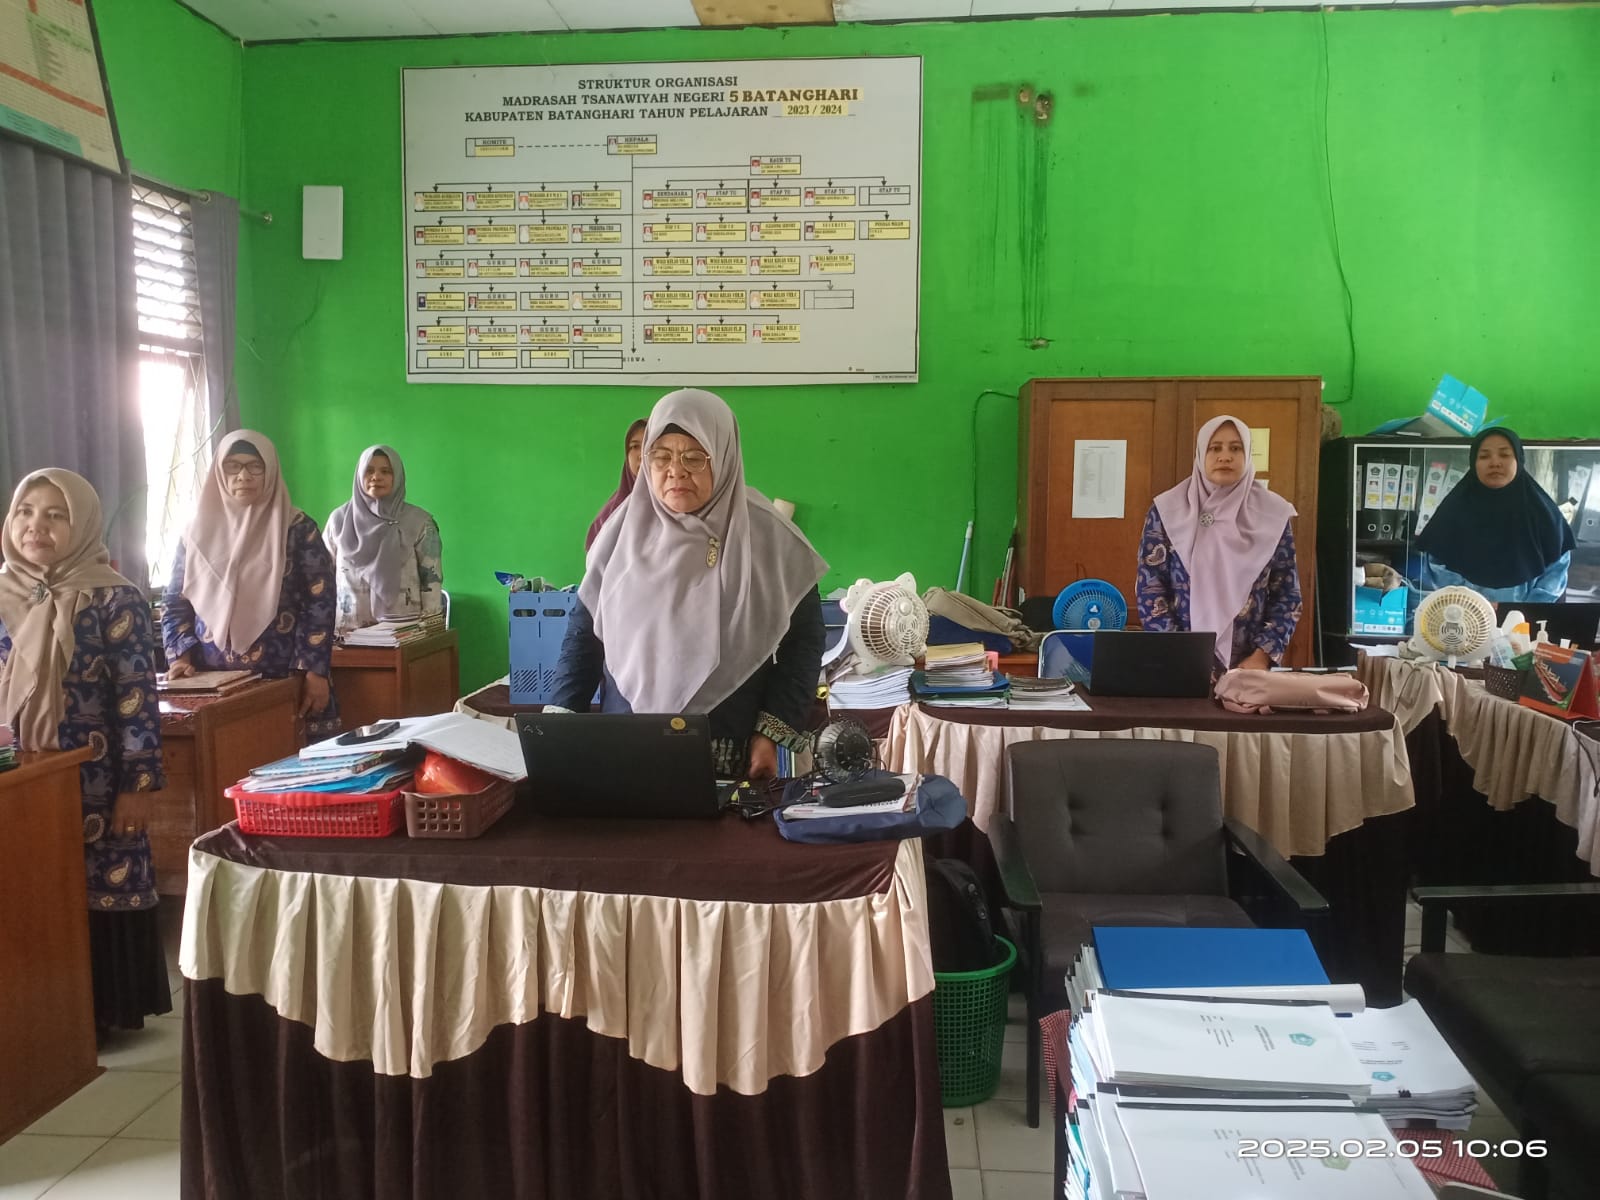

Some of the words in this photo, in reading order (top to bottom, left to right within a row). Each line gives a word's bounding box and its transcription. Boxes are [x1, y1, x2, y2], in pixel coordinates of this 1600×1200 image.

[578, 78, 651, 90] STRUKTUR
[654, 76, 738, 88] ORGANISASI
[502, 95, 577, 106] MADRASAH
[581, 93, 668, 105] TSANAWIYAH
[674, 92, 724, 103] NEGERI
[729, 90, 739, 103] 5
[742, 88, 858, 102] BATANGHARI
[464, 110, 544, 122] KABUPATEN
[548, 109, 634, 121] BATANGHARI
[638, 108, 684, 119] TAHUN
[690, 106, 768, 118] PELAJARAN
[787, 104, 810, 115] 2023
[812, 104, 818, 114] /
[820, 104, 842, 114] 2024
